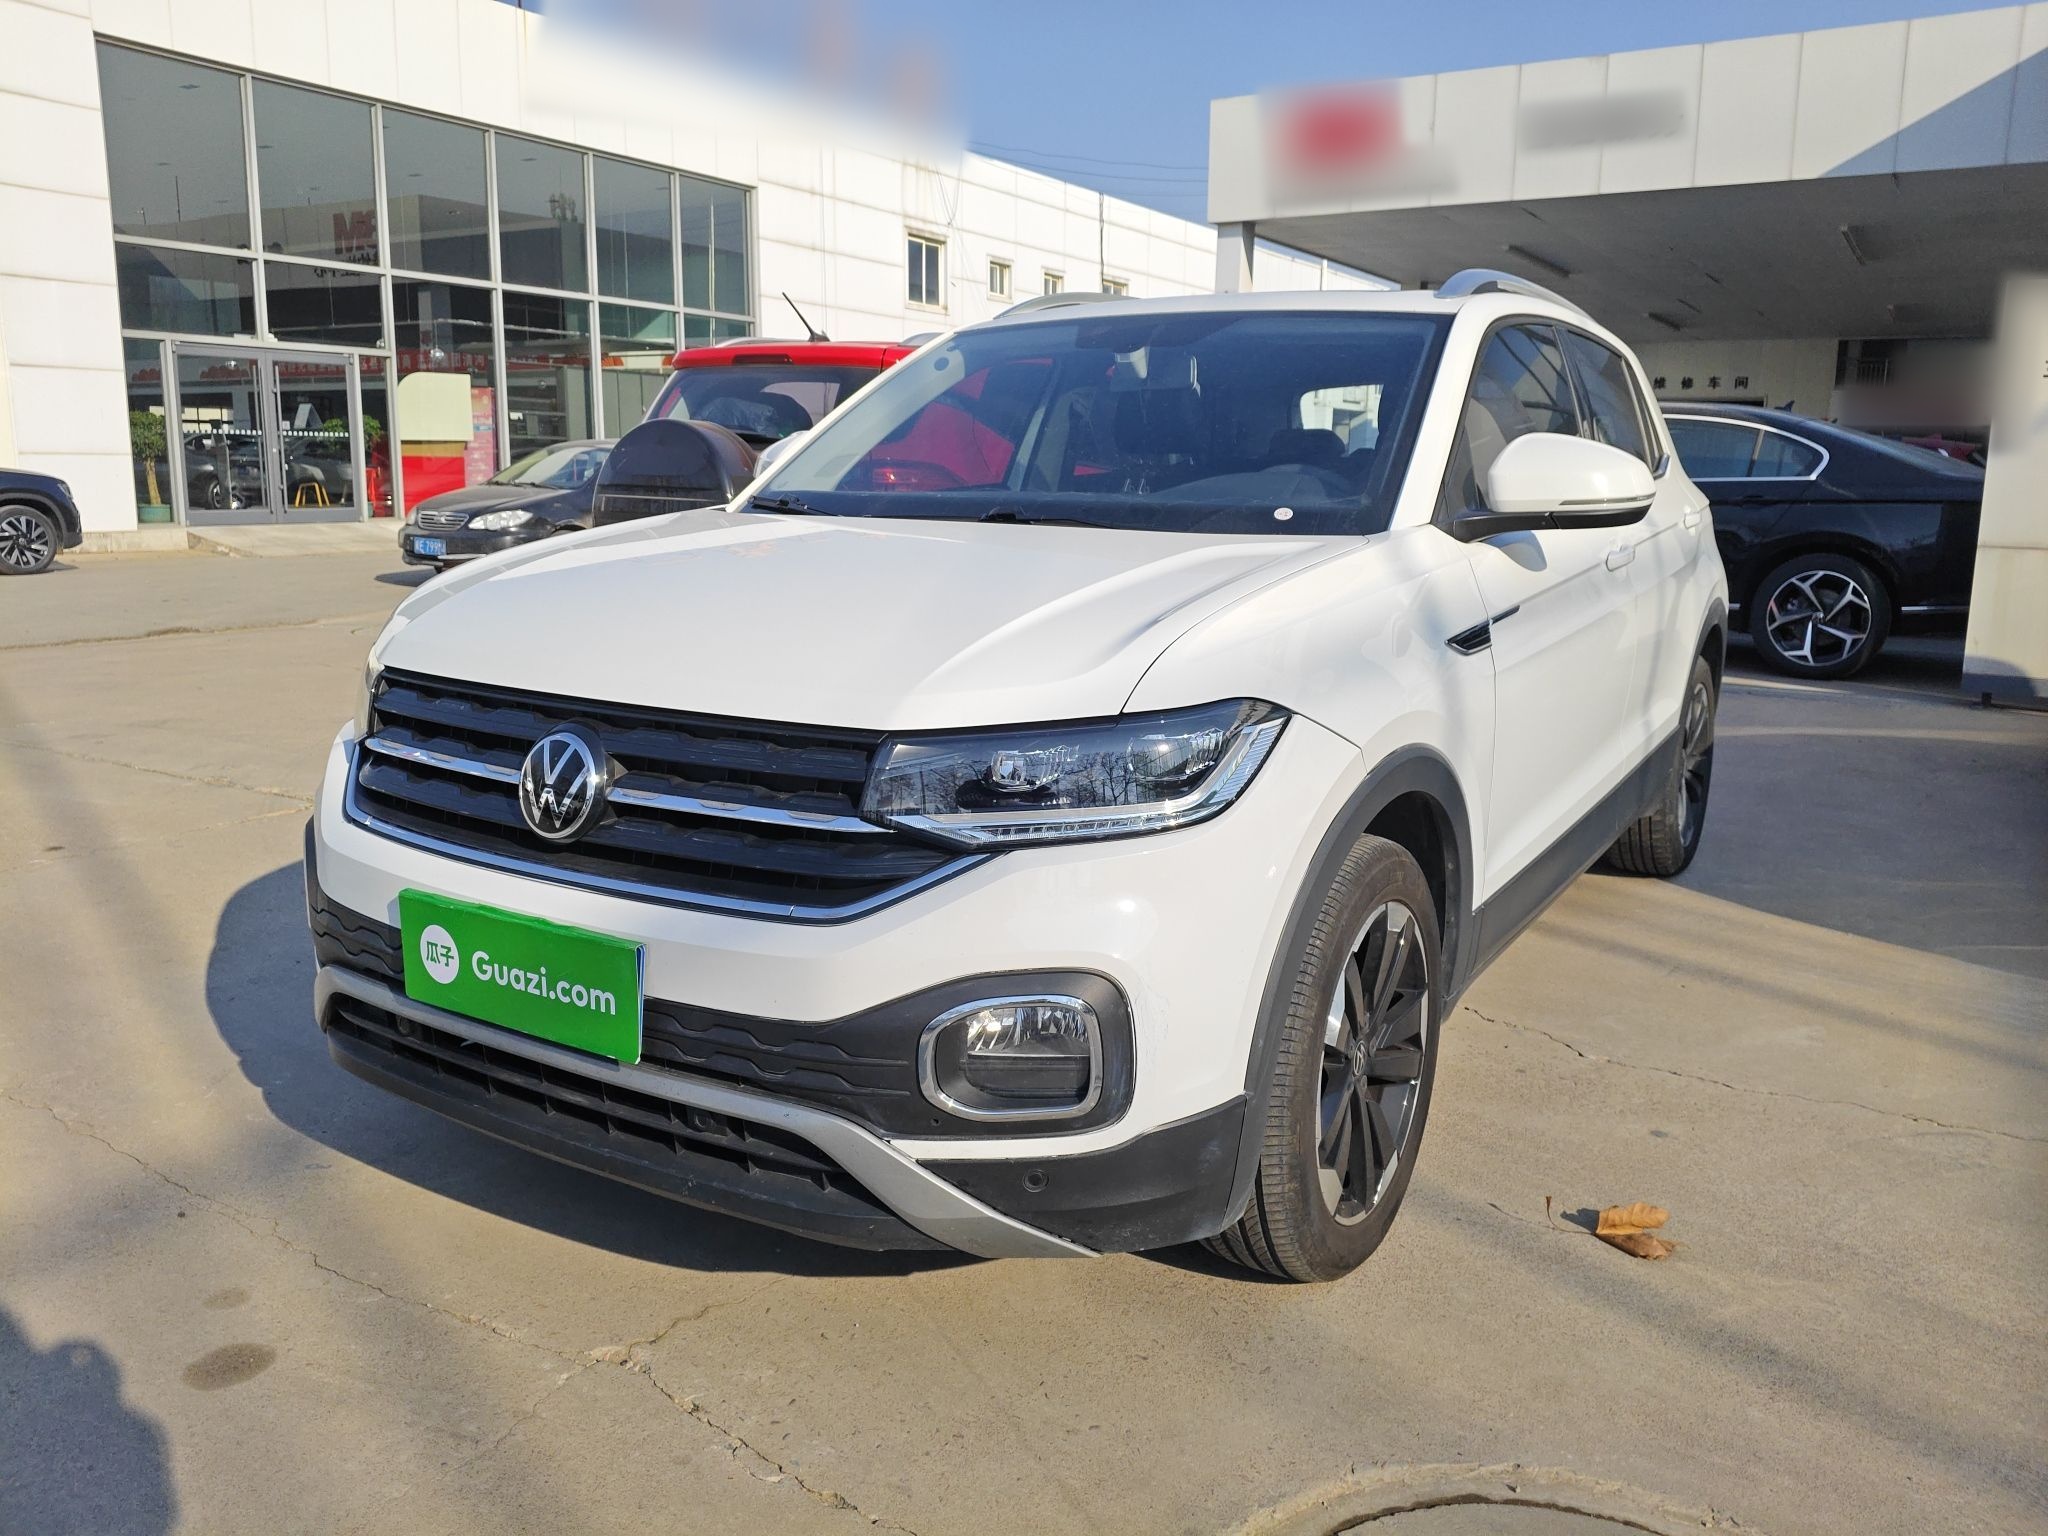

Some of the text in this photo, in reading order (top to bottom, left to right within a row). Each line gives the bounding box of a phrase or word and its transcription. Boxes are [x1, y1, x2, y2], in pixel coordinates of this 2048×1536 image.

[523, 735, 593, 832] VW
[426, 940, 454, 967] 瓜子
[471, 950, 616, 1016] Guazi.com
